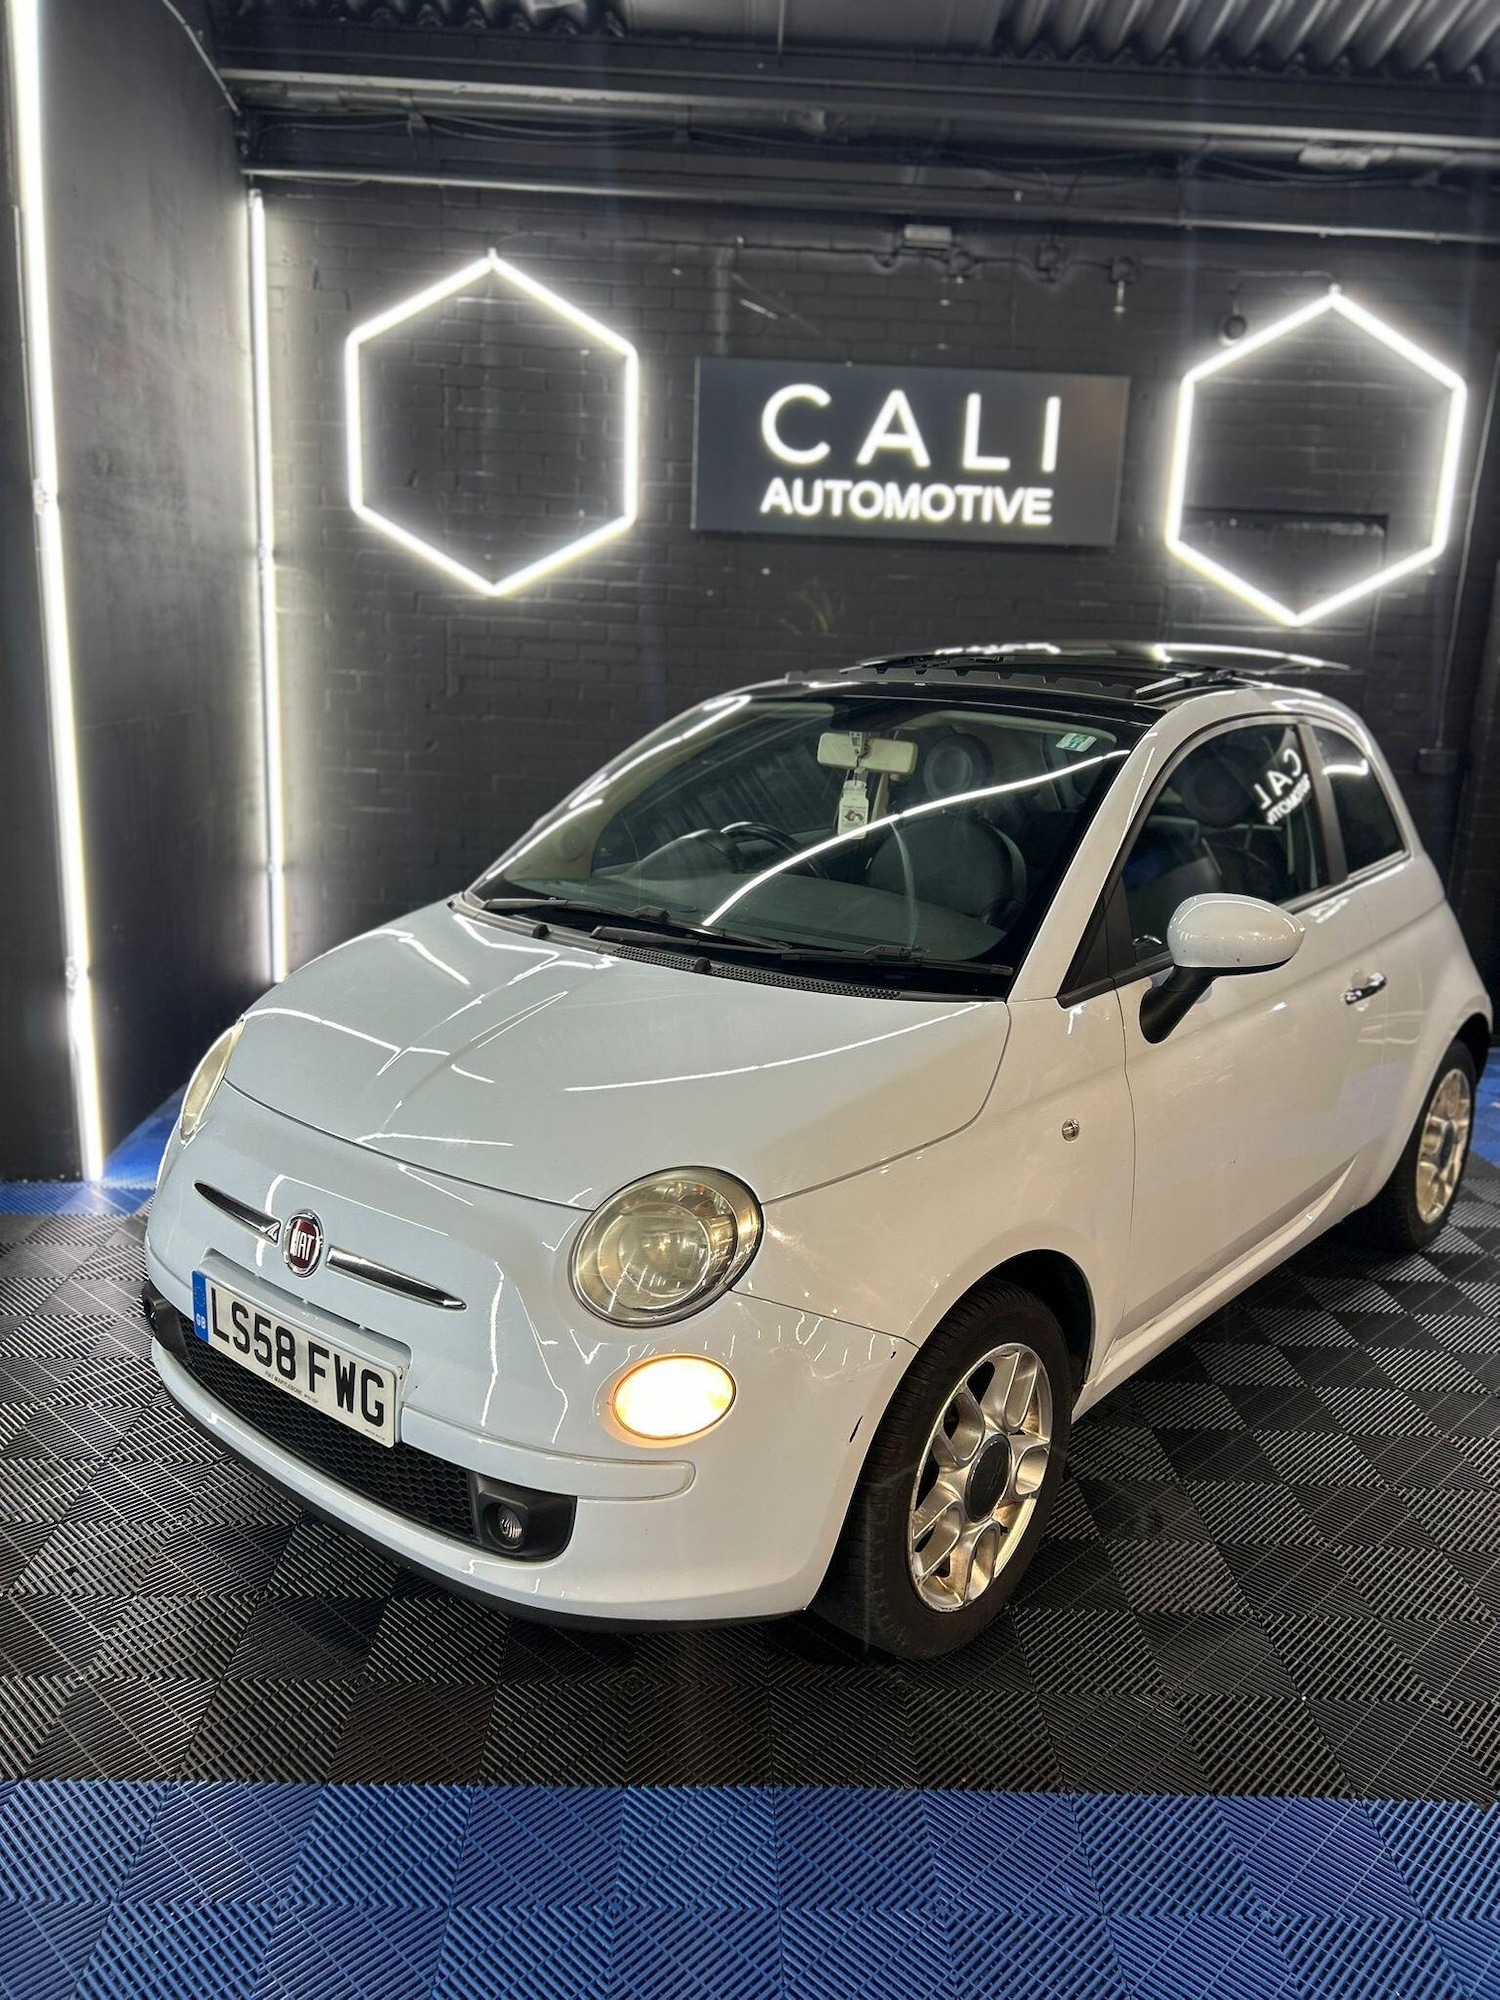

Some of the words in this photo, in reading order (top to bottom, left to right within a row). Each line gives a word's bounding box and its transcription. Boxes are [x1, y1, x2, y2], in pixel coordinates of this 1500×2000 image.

[761, 383, 1061, 473] CALI
[759, 477, 1054, 526] AUTOMOTIVE
[290, 1228, 315, 1261] FIAT
[195, 1313, 206, 1330] GB
[210, 1286, 296, 1381] LS58
[308, 1340, 384, 1427] FWG
